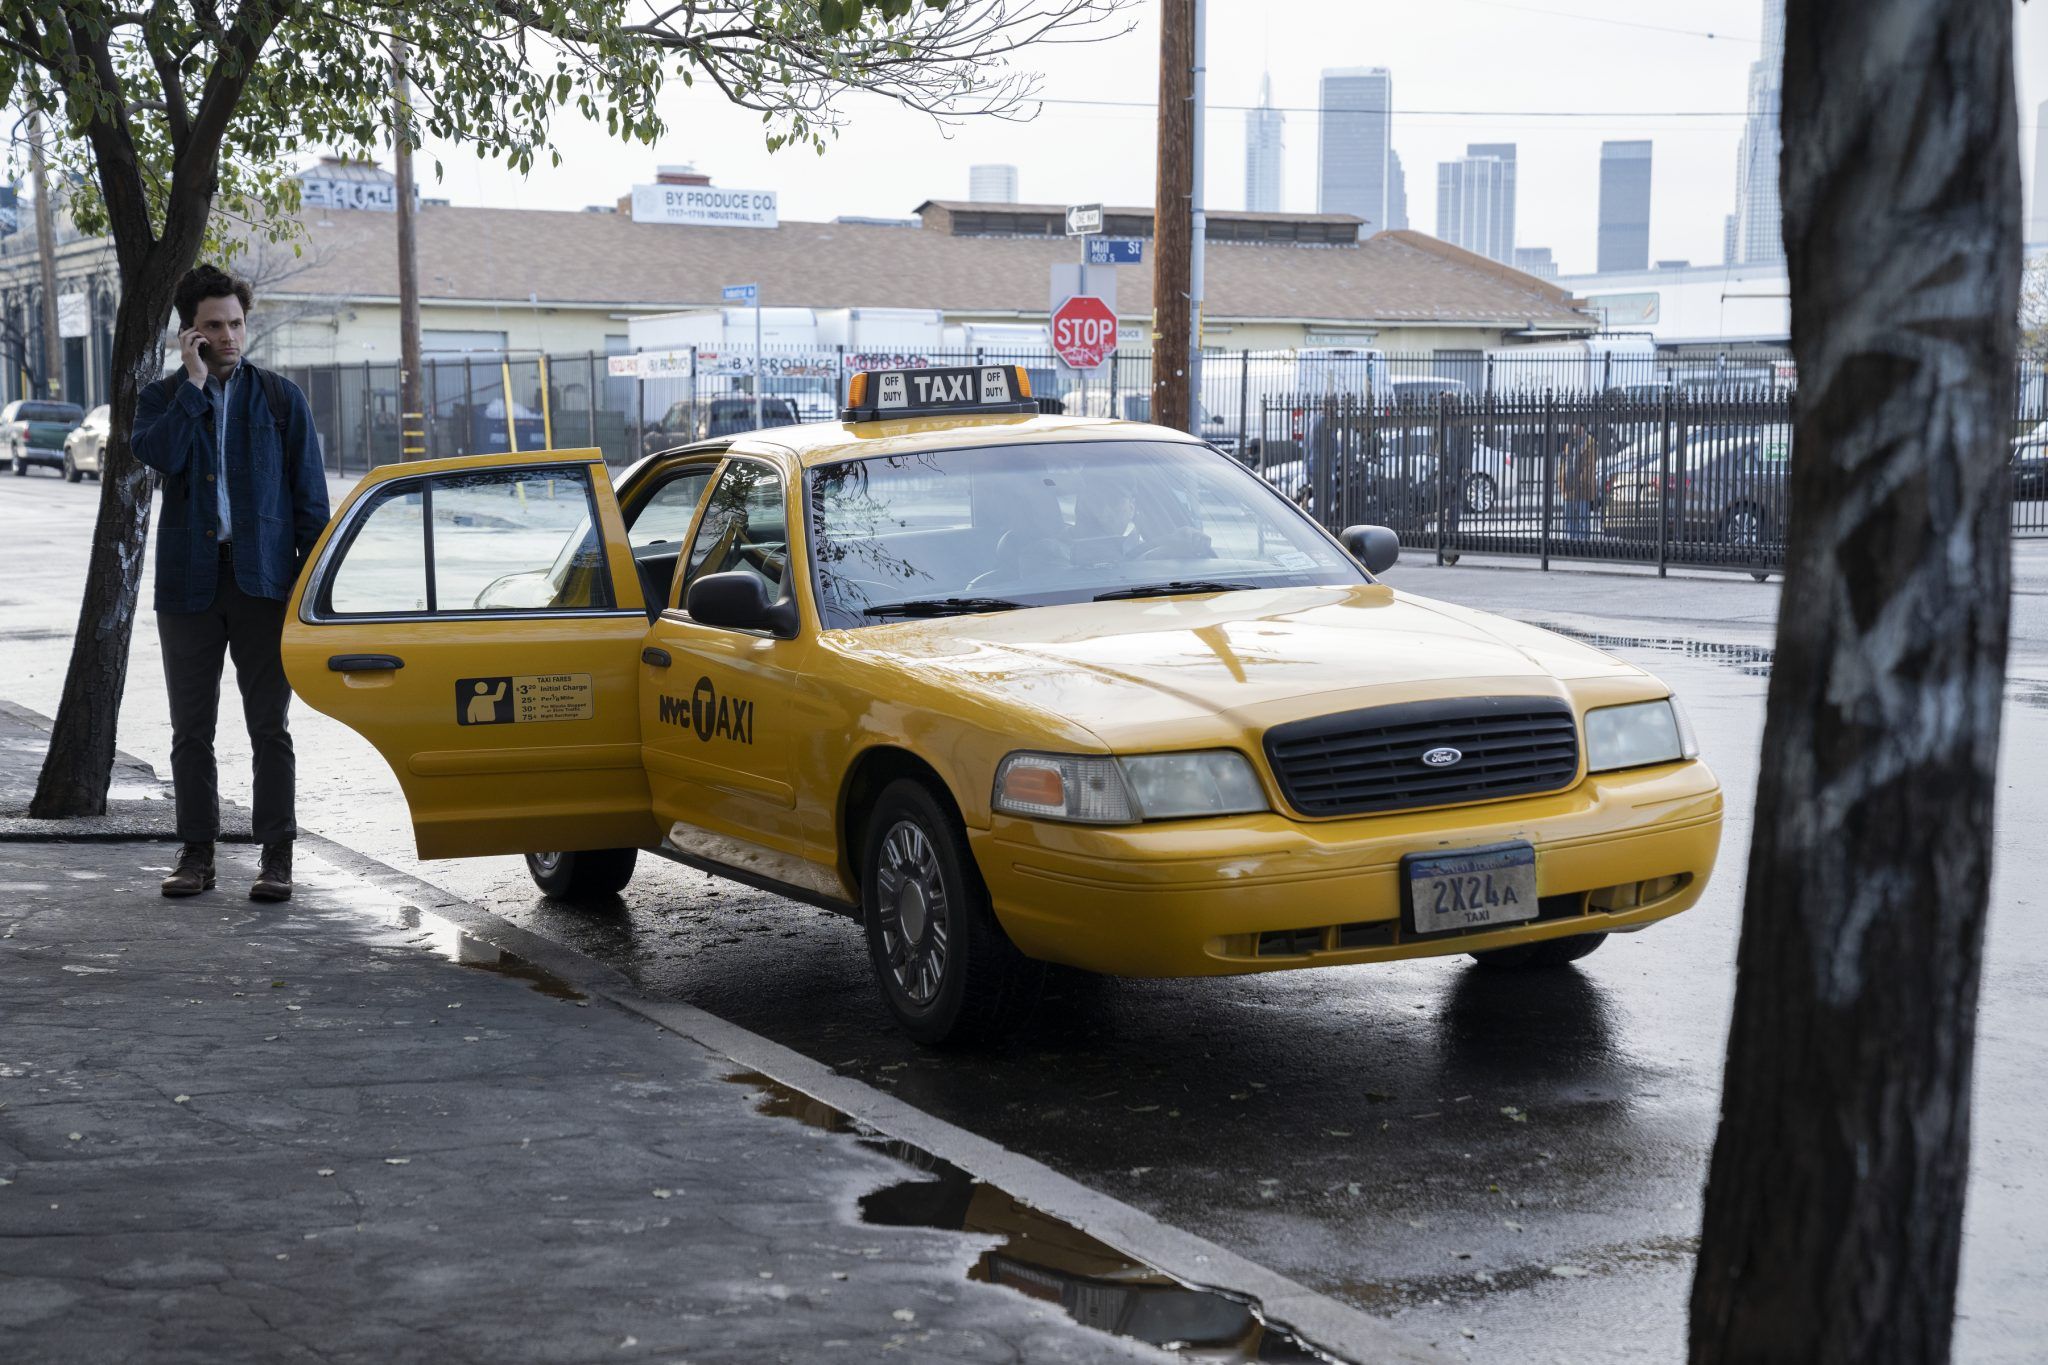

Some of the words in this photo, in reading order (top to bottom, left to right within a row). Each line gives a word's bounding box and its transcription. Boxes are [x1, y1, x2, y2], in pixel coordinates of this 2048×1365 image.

[666, 191, 683, 206] BY
[687, 192, 749, 209] PRODUCE
[753, 195, 776, 210] CO.
[708, 211, 750, 221] INDUSTRIAL
[1091, 241, 1109, 254] Mill
[1128, 241, 1140, 255] St
[1091, 253, 1107, 263] 600
[1109, 253, 1116, 263] S
[1057, 318, 1113, 346] STOP
[760, 357, 834, 372] PRODUCE
[884, 375, 899, 386] OFF
[987, 371, 1001, 382] OFF
[914, 374, 974, 403] TAXI
[985, 386, 1004, 398] DUTY
[883, 391, 902, 402] DUTY
[562, 684, 588, 692] Charge
[1464, 910, 1490, 923] TAXI
